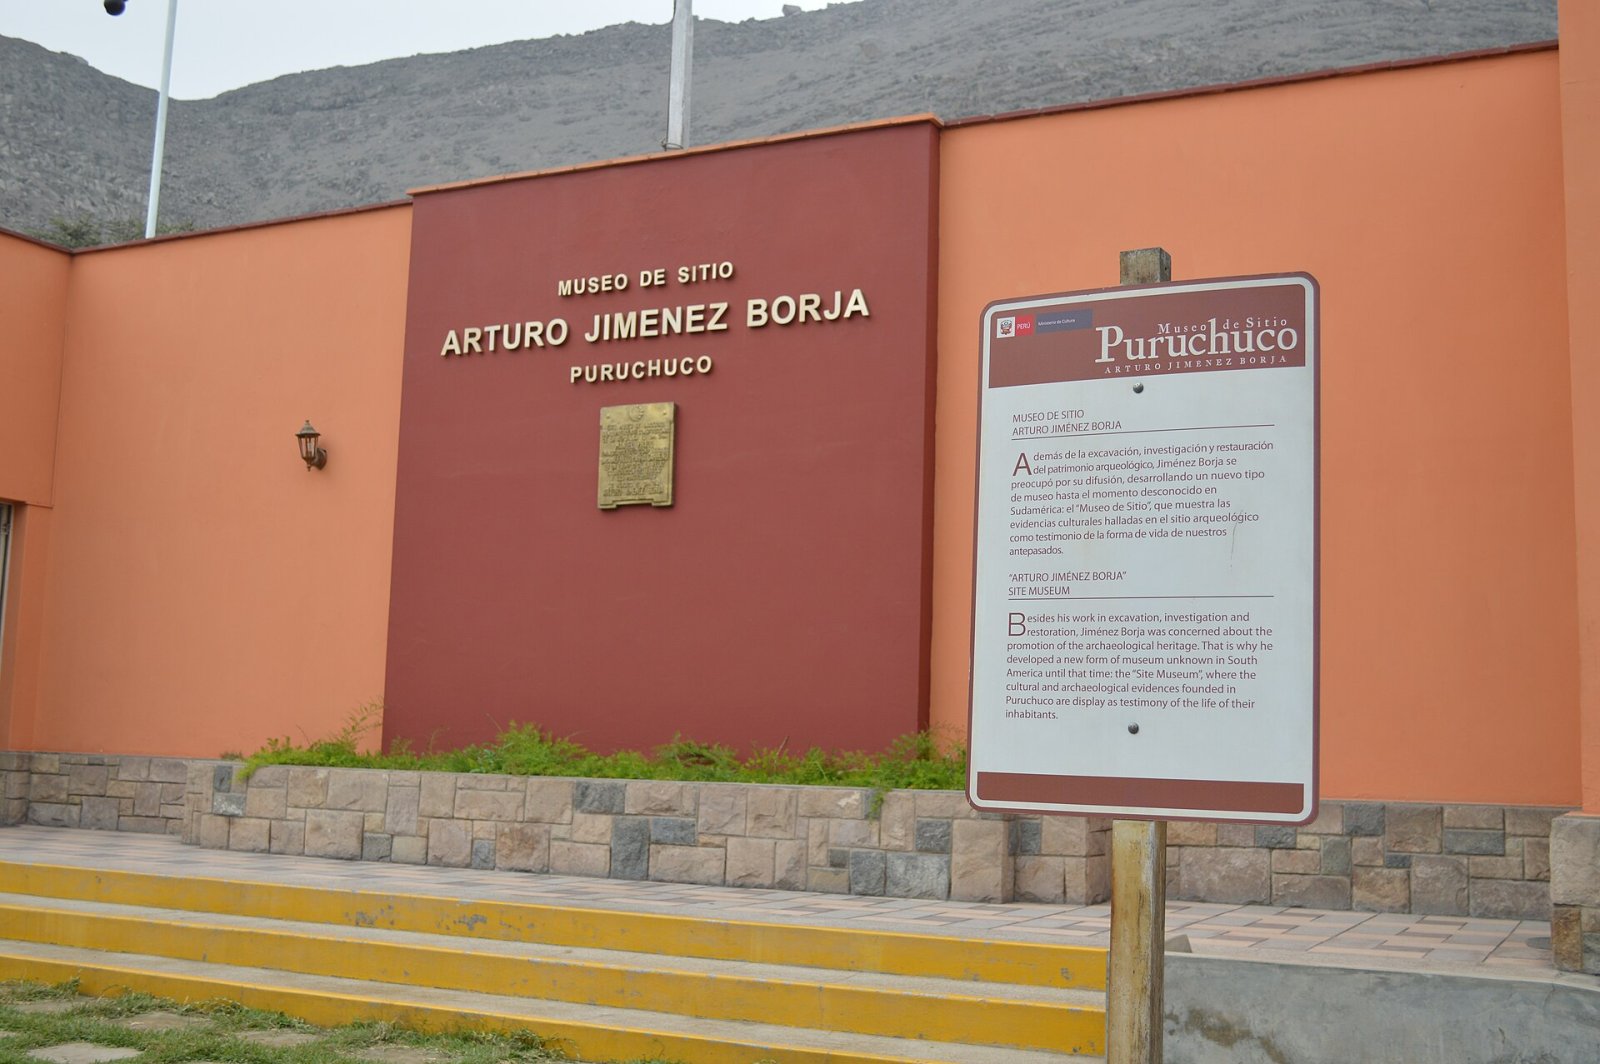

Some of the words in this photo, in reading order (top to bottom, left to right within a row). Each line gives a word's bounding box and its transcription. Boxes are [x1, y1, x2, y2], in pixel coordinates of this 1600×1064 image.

[557, 273, 628, 297] MUSEO
[639, 268, 666, 288] DE
[677, 261, 734, 283] SITIO
[440, 318, 569, 357] ARTURO
[584, 301, 729, 343] JIMENEZ
[746, 288, 870, 328] BORJA
[1157, 322, 1207, 335] Museo
[1222, 318, 1239, 330] de
[1245, 317, 1288, 328] Sitio
[1095, 318, 1298, 363] Puruchuco
[570, 355, 713, 384] PURUCHUCO
[1104, 362, 1162, 374] ARTURO
[1167, 357, 1233, 370] JIMENEZ
[1240, 355, 1288, 365] BORJA
[1012, 411, 1045, 423] MUSEO
[1047, 411, 1059, 421] DE
[1061, 409, 1084, 420] SITIO
[1012, 424, 1049, 436] ARTURO
[1050, 421, 1089, 434] JIMÉNEZ
[1091, 420, 1122, 432] BORJA
[1064, 450, 1076, 459] de
[1078, 449, 1086, 459] la
[1087, 446, 1142, 458] excavación,
[1143, 443, 1207, 457] investigación
[1208, 445, 1215, 454] y
[1216, 441, 1274, 452] restauración
[1033, 465, 1046, 474] del
[1047, 463, 1095, 476] patrimonio
[1095, 459, 1155, 473] arqueológico,
[1155, 457, 1196, 469] Jiménez
[1198, 456, 1224, 469] Borja
[1226, 458, 1237, 466] se
[1011, 478, 1053, 490] preocupó
[1055, 478, 1071, 489] por
[1073, 478, 1083, 486] su
[1085, 474, 1125, 487] difusión,
[1127, 472, 1193, 484] desarrollando
[1195, 472, 1208, 481] un
[1210, 471, 1242, 480] nuevo
[1244, 470, 1265, 481] tipo
[1010, 493, 1023, 502] de
[1023, 493, 1054, 502] museo
[1055, 490, 1080, 500] hasta
[1082, 489, 1091, 499] el
[1092, 488, 1139, 498] momento
[1140, 485, 1203, 497] desconocido
[1204, 487, 1217, 495] en
[1010, 505, 1065, 516] Sudamérica:
[1066, 504, 1075, 514] el
[1112, 502, 1125, 512] de
[1154, 501, 1173, 513] que
[1175, 500, 1215, 509] muestra
[1217, 499, 1231, 508] las
[1010, 518, 1056, 529] evidencias
[1058, 516, 1102, 527] culturales
[1104, 515, 1143, 526] halladas
[1145, 516, 1158, 524] en
[1159, 514, 1168, 524] el
[1170, 513, 1191, 523] sitio
[1193, 512, 1259, 524] arqueológico
[1009, 534, 1034, 543] como
[1035, 530, 1082, 542] testimonio
[1083, 530, 1095, 540] de
[1096, 530, 1105, 540] la
[1106, 529, 1133, 539] forma
[1134, 529, 1147, 538] de
[1149, 528, 1169, 537] vida
[1171, 527, 1183, 537] de
[1185, 527, 1227, 536] nuestros
[1009, 545, 1064, 557] antepasados.
[1051, 570, 1091, 583] JIMÉNEZ
[1008, 586, 1027, 596] SITE
[1028, 586, 1070, 595] MUSEUM
[1057, 613, 1071, 623] his
[1072, 613, 1096, 623] work
[1097, 613, 1106, 623] in
[1108, 613, 1162, 624] excavation,
[1164, 613, 1229, 624] investigation
[1230, 612, 1249, 622] and
[1027, 627, 1079, 638] restoration,
[1080, 626, 1119, 637] Jiménez
[1121, 627, 1145, 638] Borja
[1168, 626, 1221, 636] concerned
[1223, 626, 1253, 636] about
[1255, 626, 1273, 636] the
[1007, 641, 1056, 652] promotion
[1057, 641, 1067, 651] of
[1068, 641, 1084, 650] the
[1085, 640, 1155, 652] archaeological
[1156, 640, 1200, 653] heritage.
[1201, 641, 1224, 651] That
[1226, 640, 1234, 651] is
[1235, 641, 1258, 653] why
[1260, 641, 1273, 651] he
[1006, 654, 1054, 666] developed
[1085, 655, 1109, 665] form
[1110, 655, 1121, 665] of
[1122, 657, 1164, 665] museum
[1166, 655, 1213, 665] unknown
[1215, 655, 1225, 665] in
[1227, 655, 1258, 665] South
[1006, 668, 1043, 678] America
[1045, 668, 1066, 678] until
[1068, 668, 1087, 678] that
[1088, 669, 1113, 679] time:
[1114, 669, 1131, 679] the
[1205, 669, 1237, 680] where
[1239, 669, 1256, 680] the
[1006, 682, 1040, 692] cultural
[1041, 682, 1059, 692] and
[1061, 682, 1129, 695] archaeological
[1131, 683, 1180, 693] evidences
[1181, 683, 1224, 694] founded
[1226, 684, 1236, 694] in
[1006, 695, 1054, 706] Puruchuco
[1056, 697, 1071, 706] are
[1072, 696, 1105, 708] display
[1107, 698, 1118, 706] as
[1119, 697, 1167, 709] testimony
[1169, 697, 1180, 708] of
[1182, 697, 1200, 708] the
[1201, 698, 1217, 708] life
[1218, 698, 1230, 708] of
[1231, 698, 1255, 709] their
[1005, 709, 1058, 720] inhabitants.
